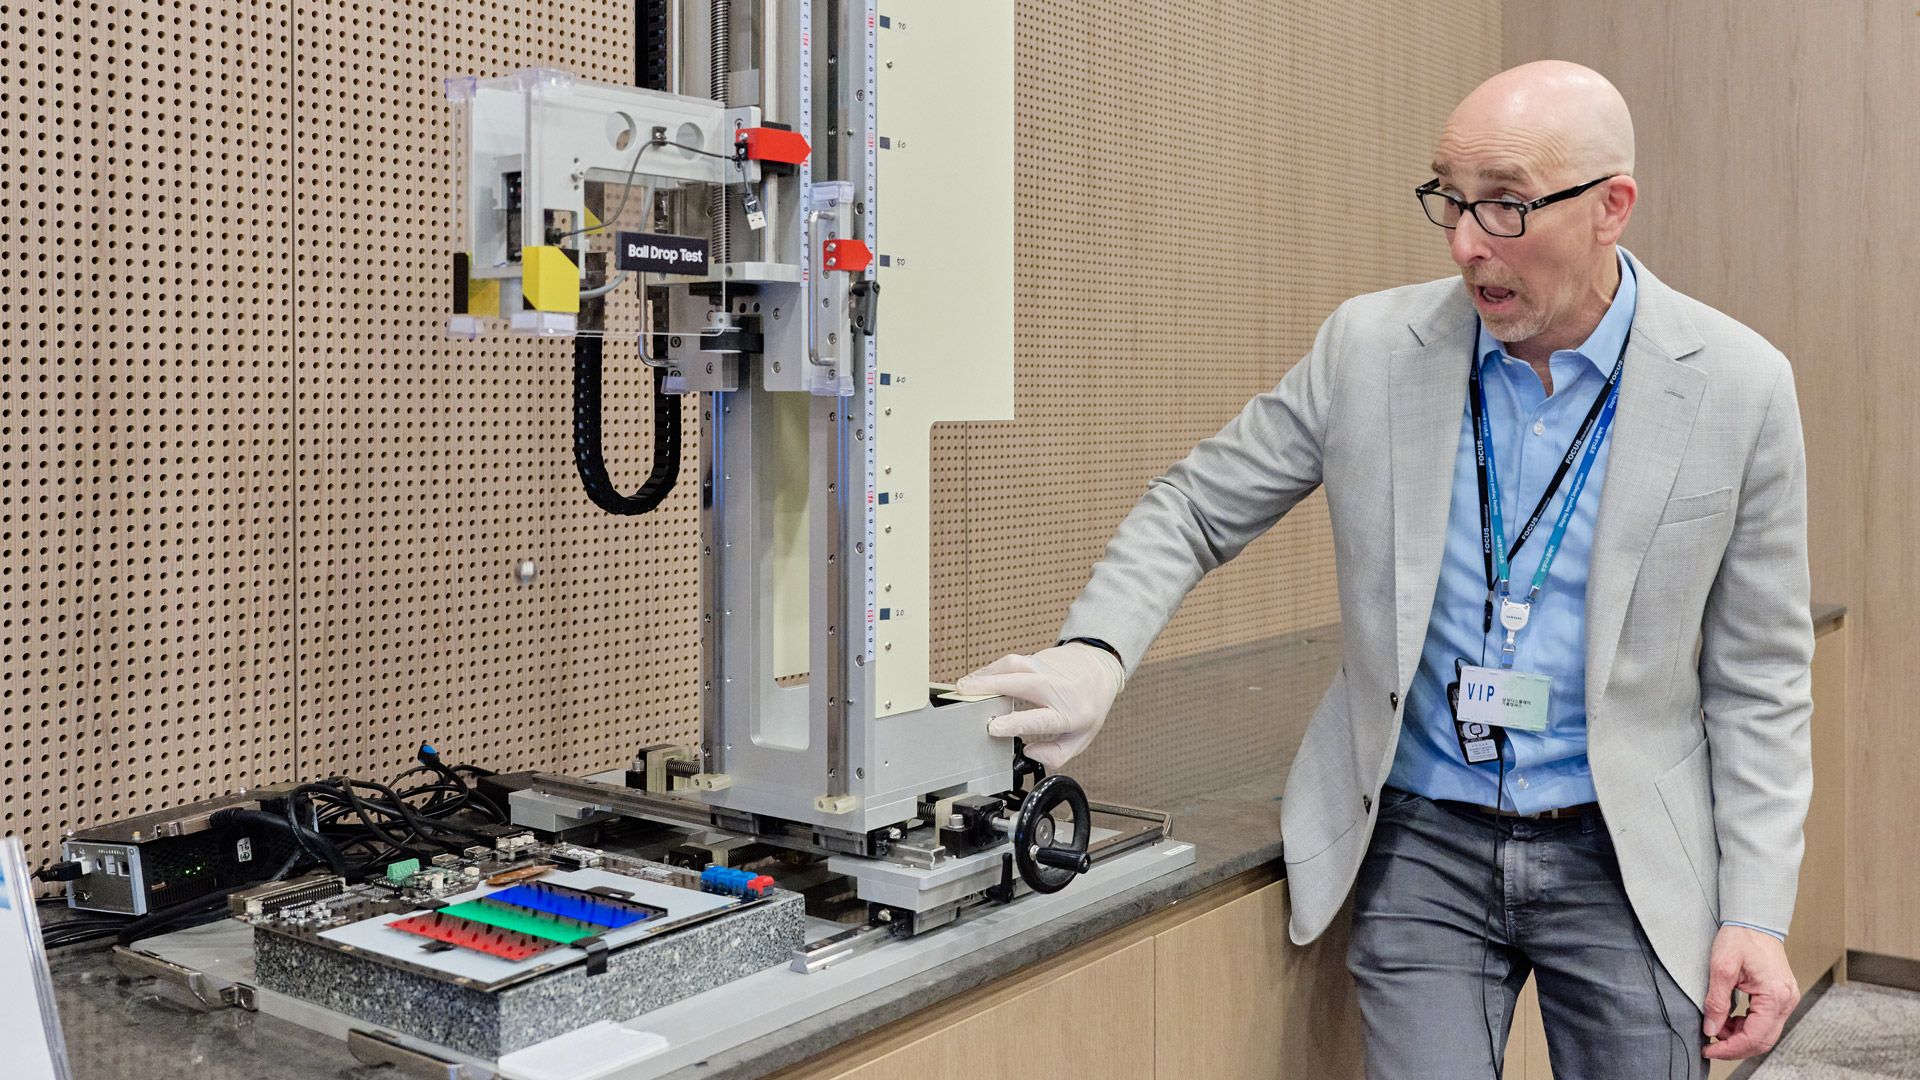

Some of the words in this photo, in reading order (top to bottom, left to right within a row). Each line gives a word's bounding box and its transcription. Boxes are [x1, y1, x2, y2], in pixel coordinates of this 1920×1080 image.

[628, 244, 649, 258] Ball
[650, 246, 678, 264] Drop
[680, 248, 702, 262] Test
[1609, 360, 1623, 385] FOCUS
[1477, 440, 1485, 466] FOCUS
[1565, 439, 1582, 464] FOCUS
[1521, 516, 1538, 540] FOCUS
[1468, 682, 1495, 702] VIP
